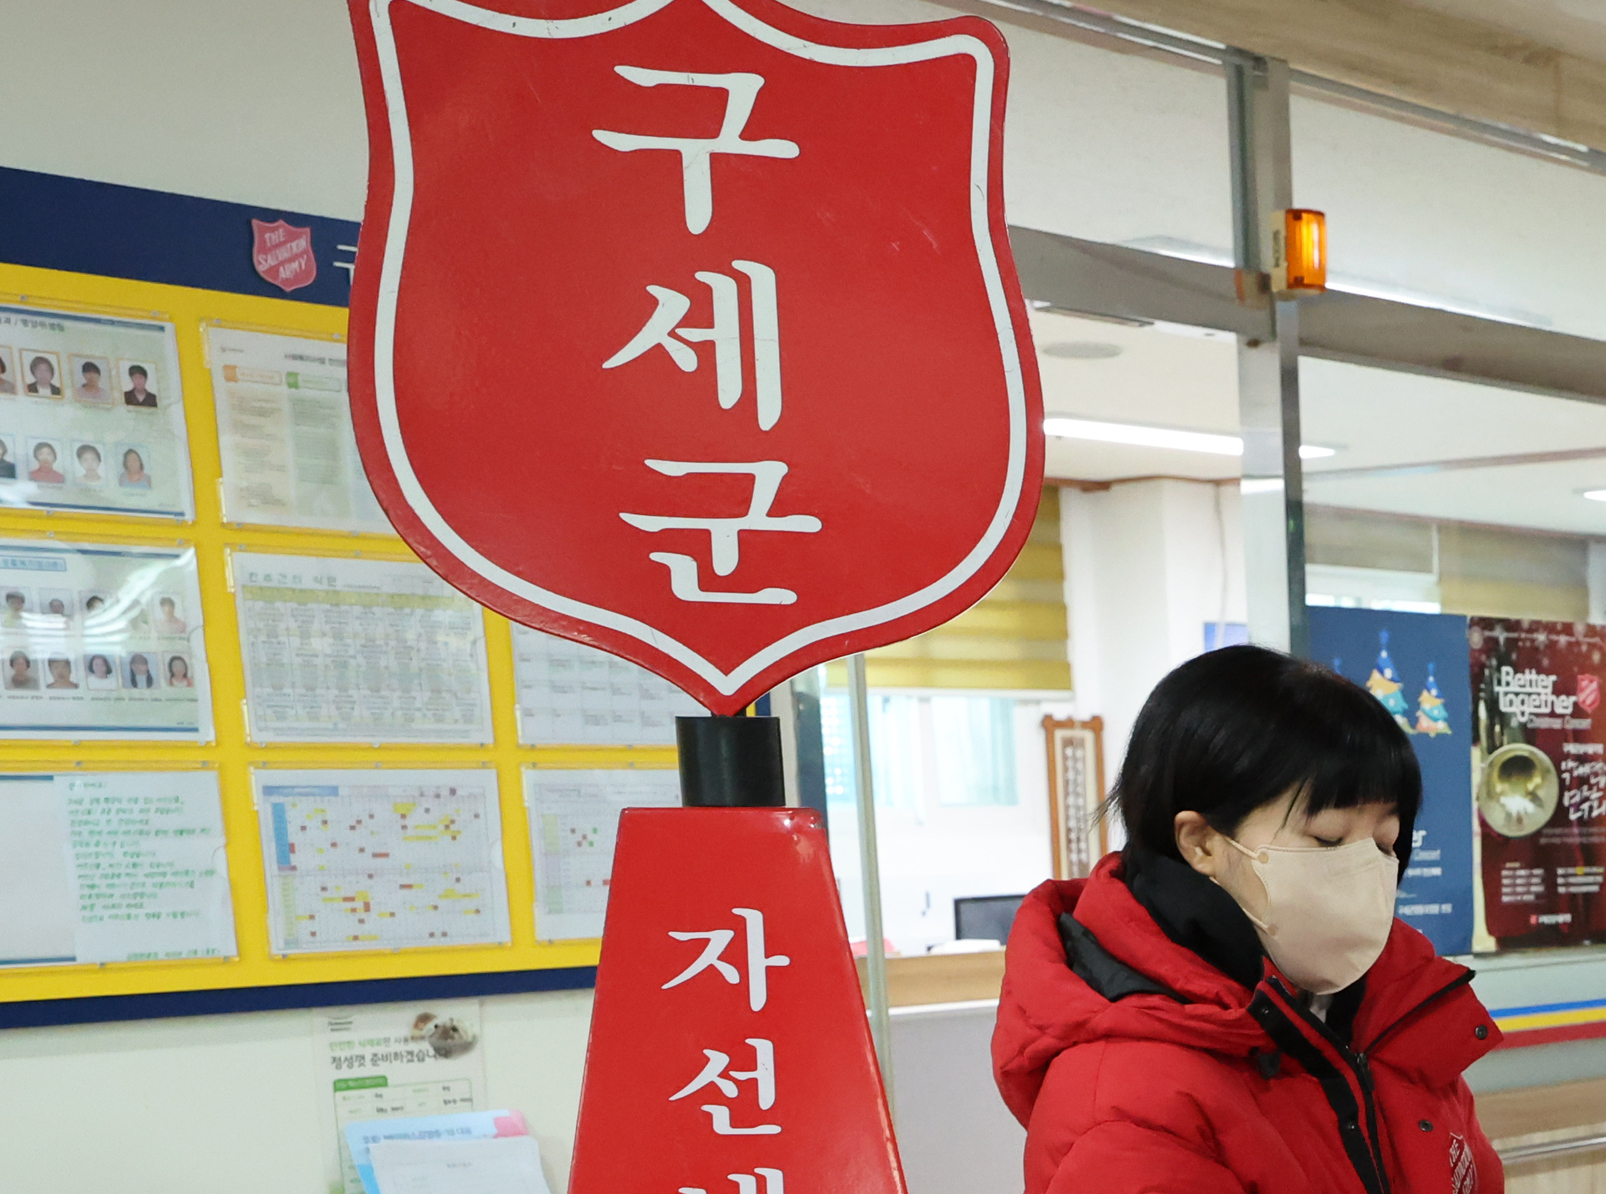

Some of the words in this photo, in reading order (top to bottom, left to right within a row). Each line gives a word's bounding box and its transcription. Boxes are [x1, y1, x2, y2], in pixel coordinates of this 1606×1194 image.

[265, 228, 286, 248] THE
[278, 254, 308, 280] ARMY
[592, 65, 822, 605] 구세군
[1500, 665, 1557, 689] Better
[1494, 686, 1578, 722] Together
